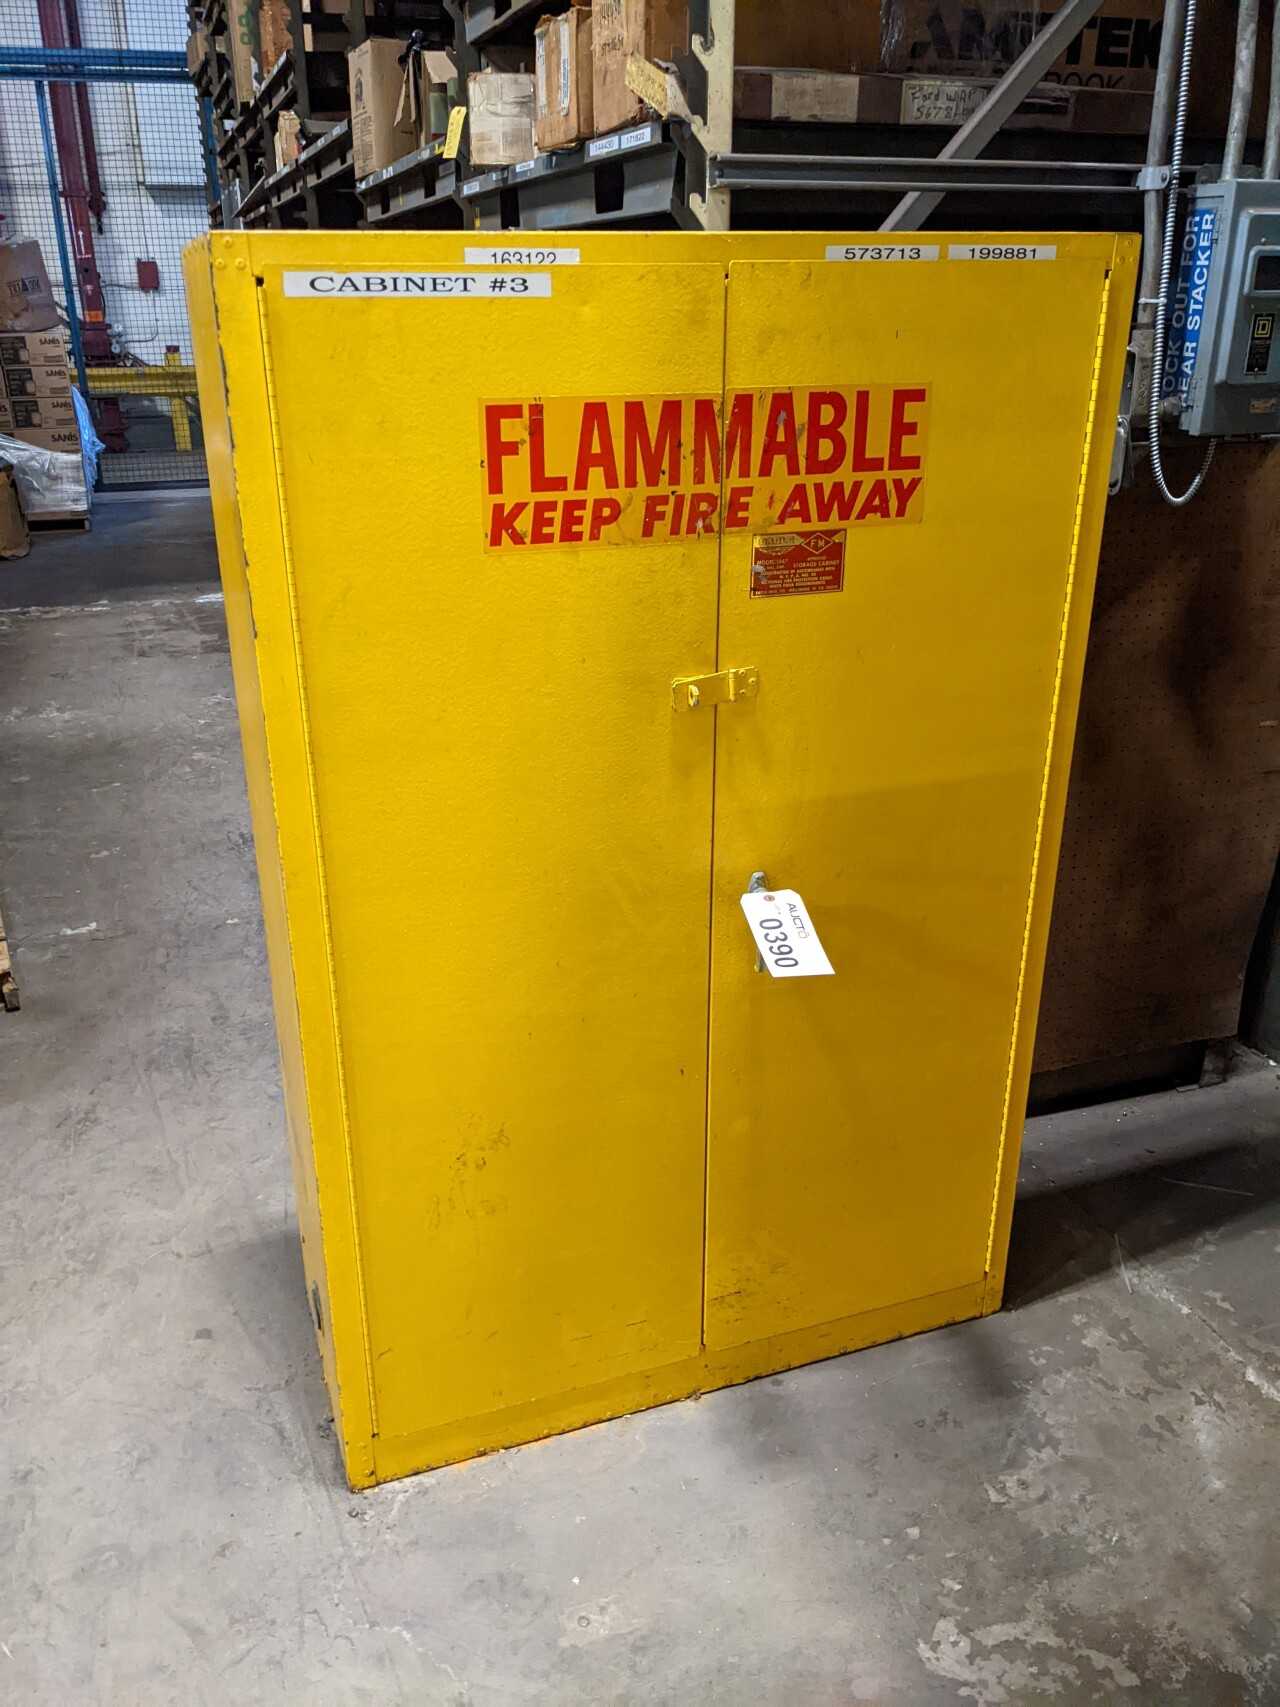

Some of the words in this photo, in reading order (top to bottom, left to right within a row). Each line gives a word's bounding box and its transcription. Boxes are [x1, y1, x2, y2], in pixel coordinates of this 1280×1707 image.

[844, 247, 921, 260] 573713
[968, 247, 1037, 260] 199881
[1180, 214, 1200, 266] FOR
[309, 276, 476, 293] CABINET
[489, 276, 529, 293] #3
[1186, 213, 1215, 331] STACKER
[1172, 280, 1191, 329] OUT
[1162, 339, 1183, 392] OCK
[484, 388, 926, 495] FLAMMABLE
[489, 496, 622, 546] KEEP
[641, 486, 754, 538] FIRE
[775, 477, 922, 525] AWAY
[759, 918, 799, 968] 0390
